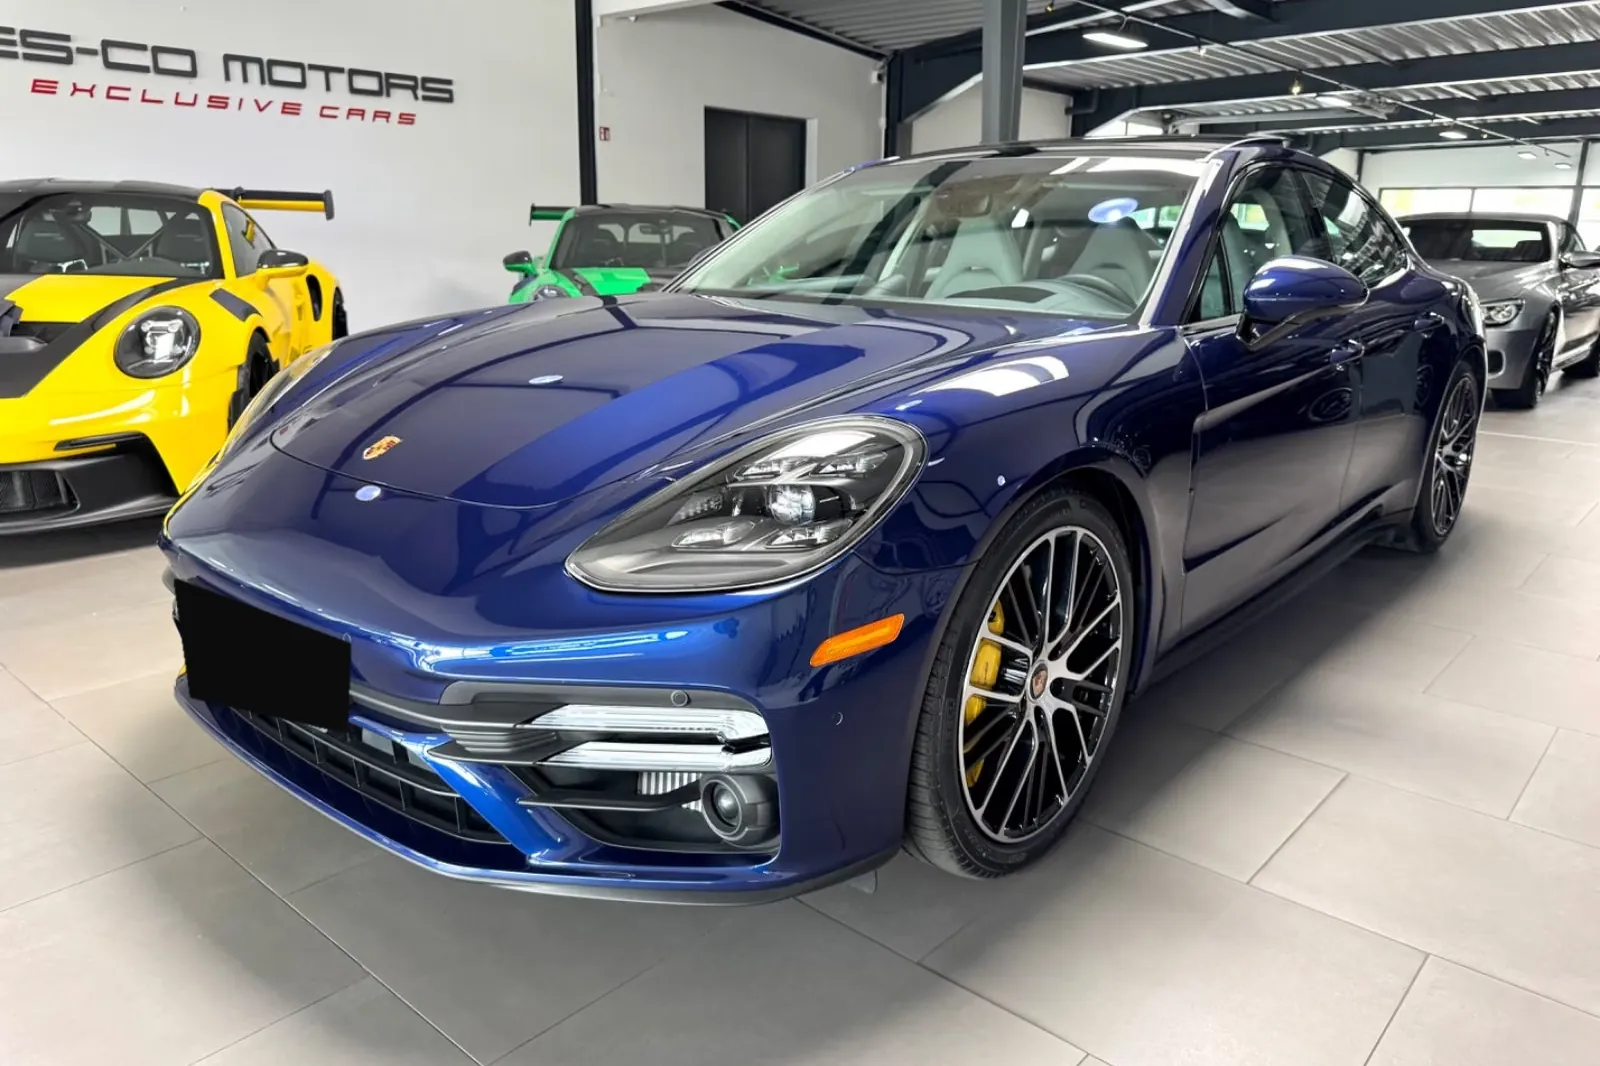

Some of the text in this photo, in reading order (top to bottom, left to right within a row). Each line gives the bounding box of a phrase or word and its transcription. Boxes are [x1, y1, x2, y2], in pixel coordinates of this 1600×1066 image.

[31, 79, 416, 125] EXCLUSIVE CARS
[223, 54, 454, 103] MOTORS
